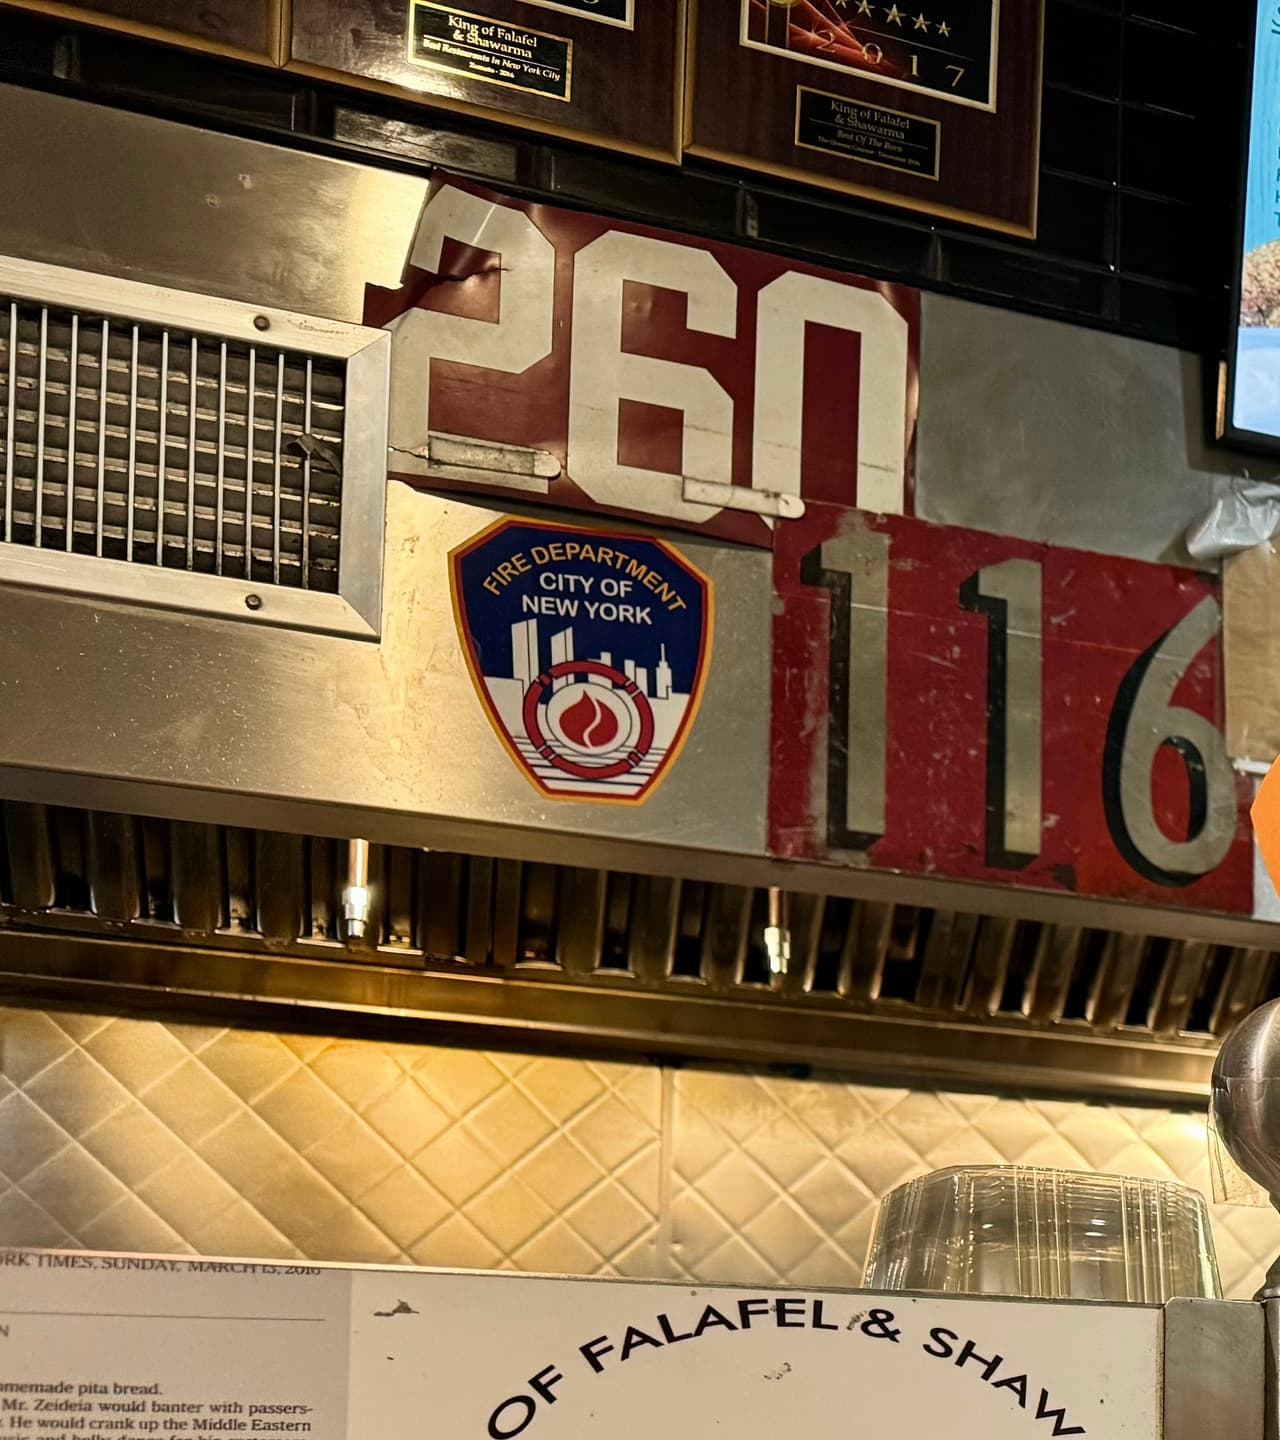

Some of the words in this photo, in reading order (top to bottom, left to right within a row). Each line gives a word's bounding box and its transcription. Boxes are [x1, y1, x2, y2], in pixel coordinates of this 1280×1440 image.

[448, 15, 479, 35] King
[481, 25, 493, 36] of
[498, 28, 537, 48] Falafel
[453, 30, 465, 41] &
[467, 31, 532, 58] Shawarma
[482, 553, 530, 596] FIRE
[531, 541, 688, 614] DEPARTMENT
[539, 572, 593, 596] CITY
[599, 577, 633, 598] OF
[522, 594, 578, 620] NEW
[584, 597, 653, 625] YORK
[800, 531, 1236, 888] 116
[102, 1257, 181, 1273] SUNDAY,
[488, 1364, 566, 1440] OF
[579, 1298, 839, 1374] FALAFEL
[860, 1308, 901, 1343] &
